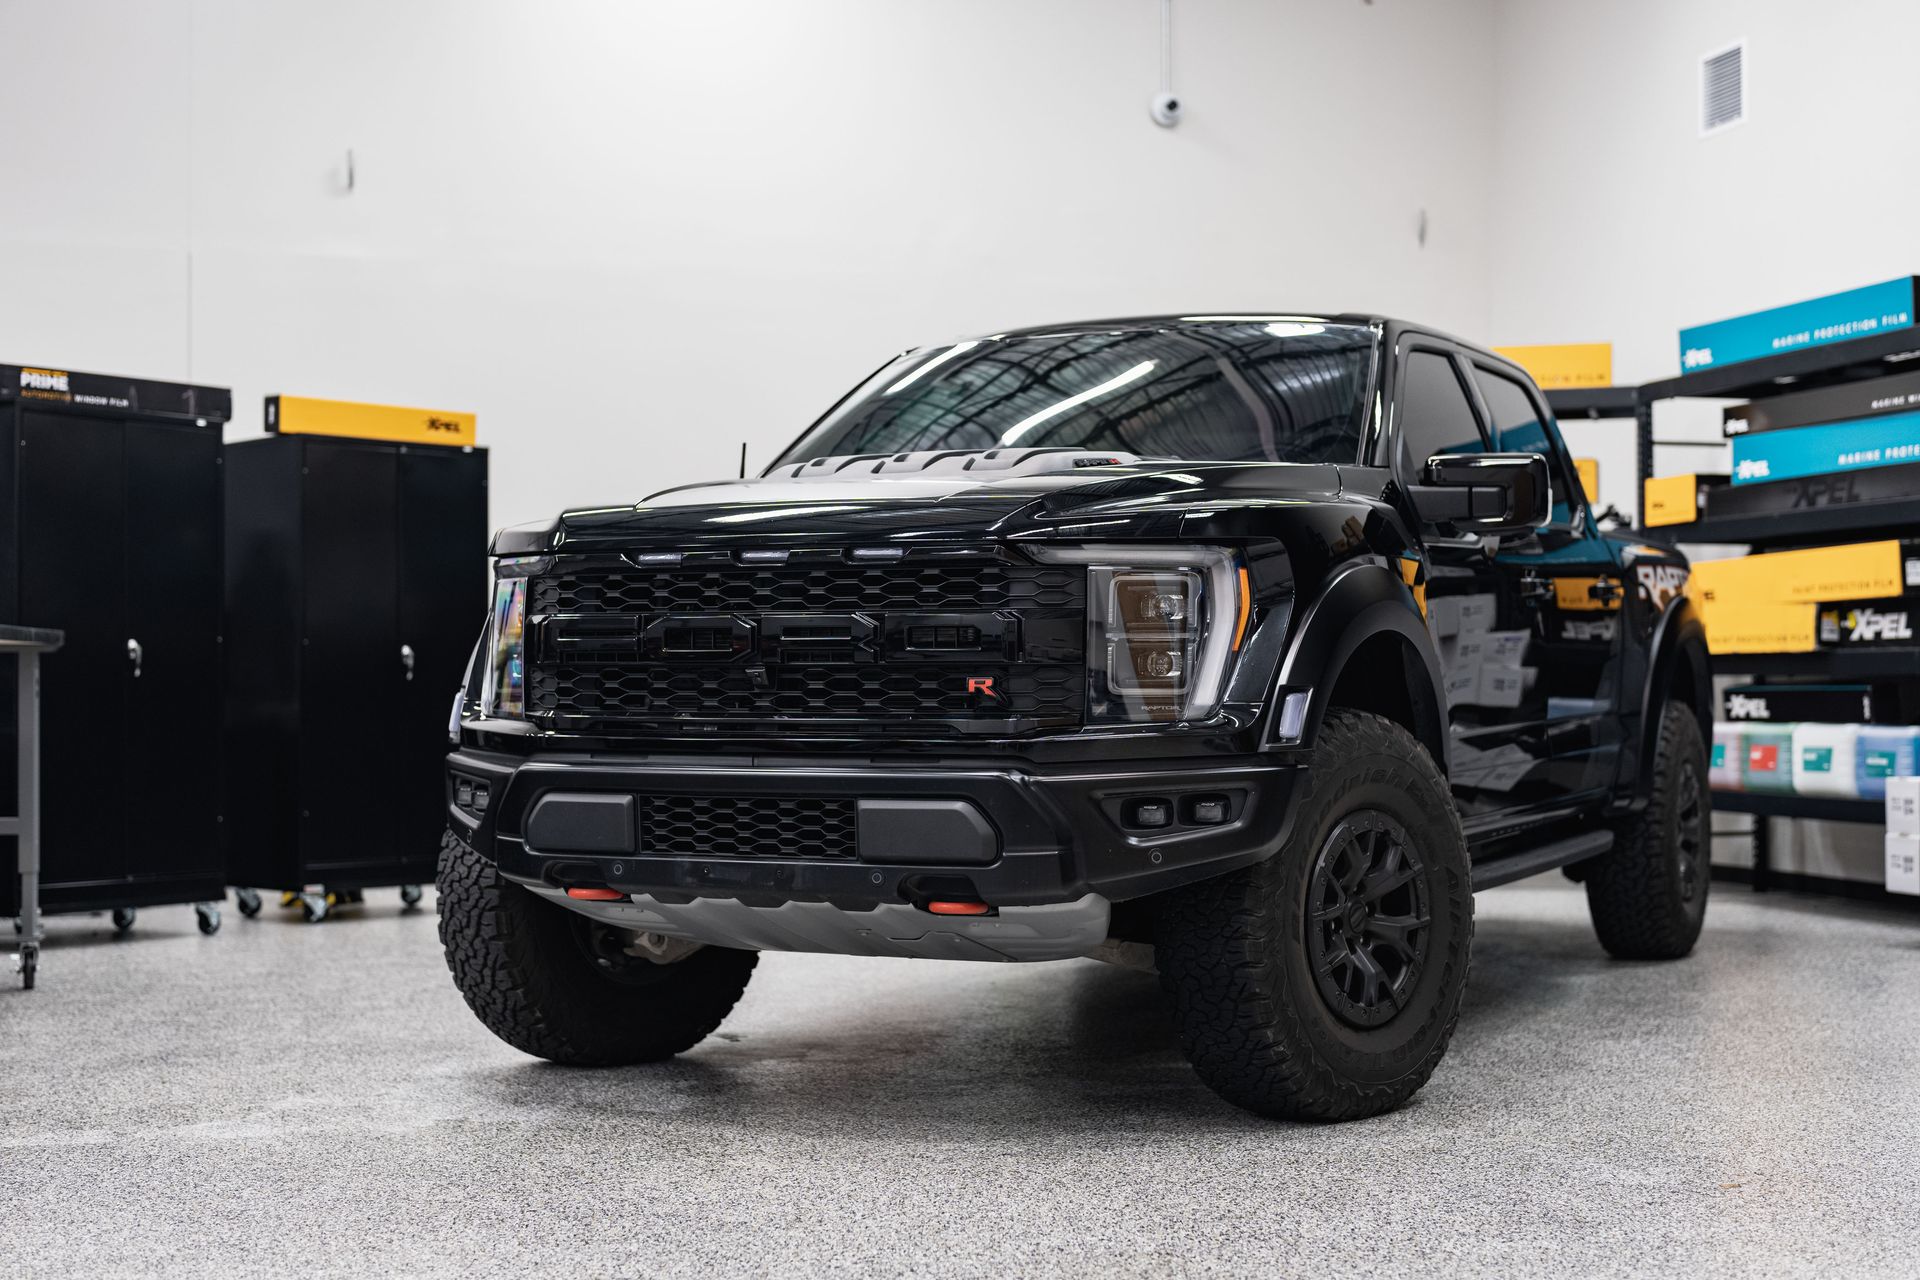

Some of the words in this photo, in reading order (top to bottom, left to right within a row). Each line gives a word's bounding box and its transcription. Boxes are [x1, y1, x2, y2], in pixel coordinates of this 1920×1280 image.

[1772, 330, 1810, 349] MARINE
[1813, 317, 1878, 340] PROTECTION
[1882, 312, 1908, 327] FILM
[20, 370, 69, 391] PRIME
[1838, 449, 1881, 466] MARINE
[1791, 477, 1862, 508] XPEL
[1848, 607, 1912, 641] XPEL
[967, 677, 998, 698] R
[1729, 694, 1770, 719] XPEL
